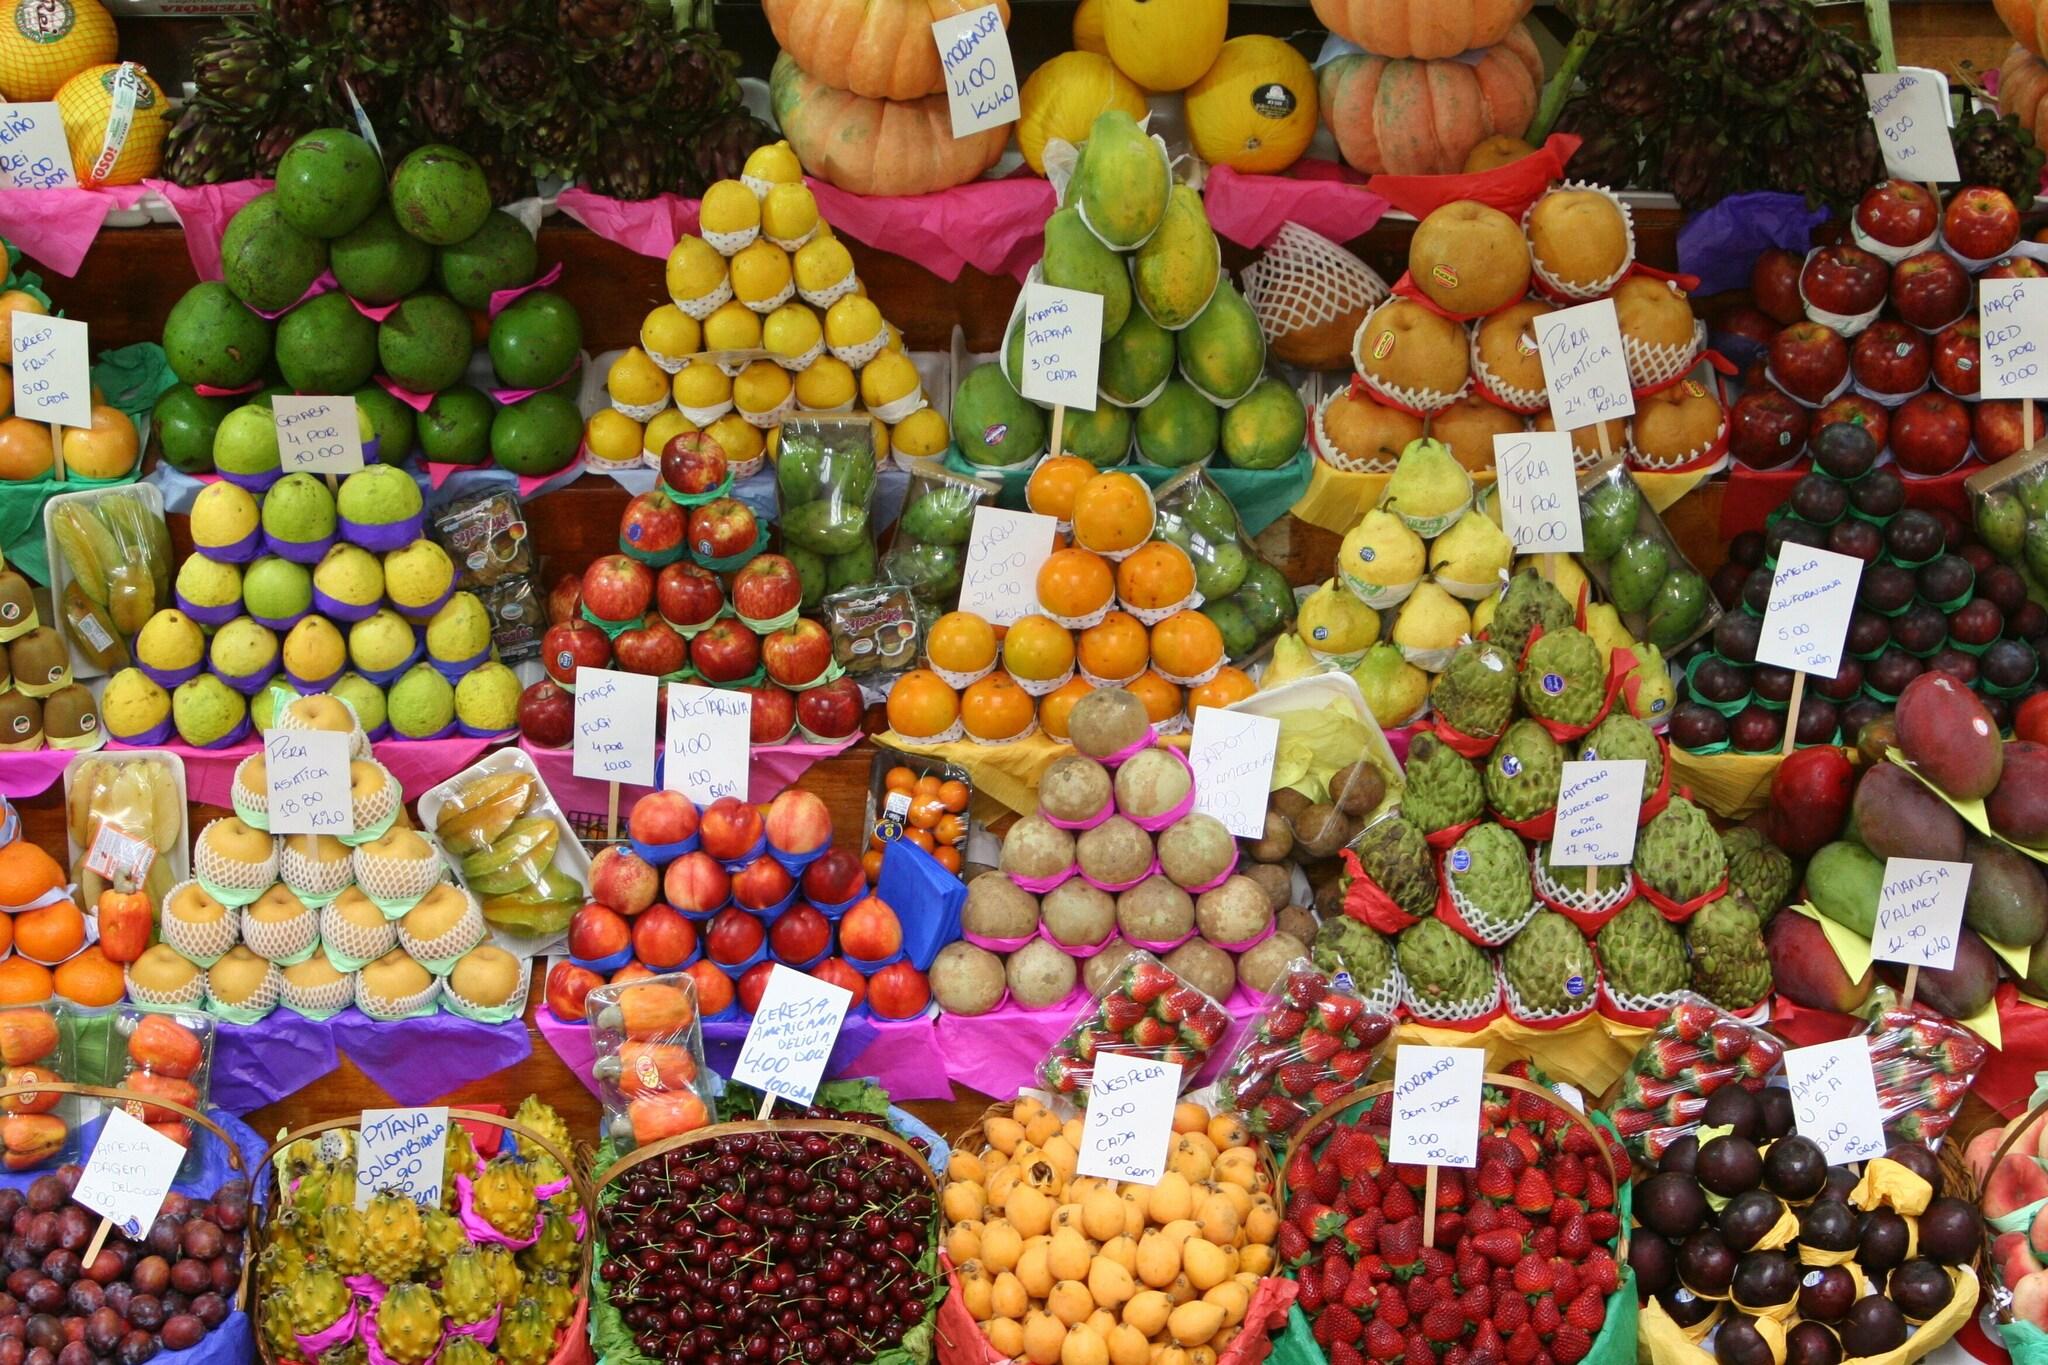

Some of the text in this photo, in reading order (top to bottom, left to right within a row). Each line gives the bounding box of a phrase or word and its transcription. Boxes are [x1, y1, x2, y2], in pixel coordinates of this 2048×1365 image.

[1028, 300, 1069, 325] MAMÃO
[1983, 282, 2025, 317] MAÇÃ
[1027, 325, 1073, 347] PAPAYA
[1541, 322, 1590, 366] PERA
[1985, 325, 2022, 350] RED
[1991, 354, 2004, 367] 3
[2008, 341, 2036, 362] POR
[1046, 369, 1077, 382] CADA
[37, 391, 69, 406] CADA
[276, 405, 331, 427] GOIABA
[286, 427, 338, 445] 4 POR
[1501, 442, 1550, 500] PERA
[1512, 492, 1560, 514] 4 POR
[1513, 520, 1567, 546] 10.00
[577, 680, 617, 706] MAÇÃ
[268, 735, 307, 764] PERA
[592, 741, 624, 754] 4 POR
[274, 766, 328, 792] ASIATICA
[688, 768, 711, 787] 100
[1562, 769, 1608, 800] ATEMOIA
[756, 997, 830, 1025] CEREJA
[1092, 1066, 1165, 1097] NESPERA
[1395, 1056, 1455, 1100] MORANGO
[1790, 1055, 1840, 1101] AMEIXA
[1095, 1102, 1136, 1127] 3.00
[1431, 1096, 1460, 1112] DOCE
[361, 1112, 430, 1149] PITAYA
[1096, 1131, 1136, 1152] CADA
[356, 1124, 445, 1186] COLOMBIANA
[1108, 1153, 1130, 1166] 100
